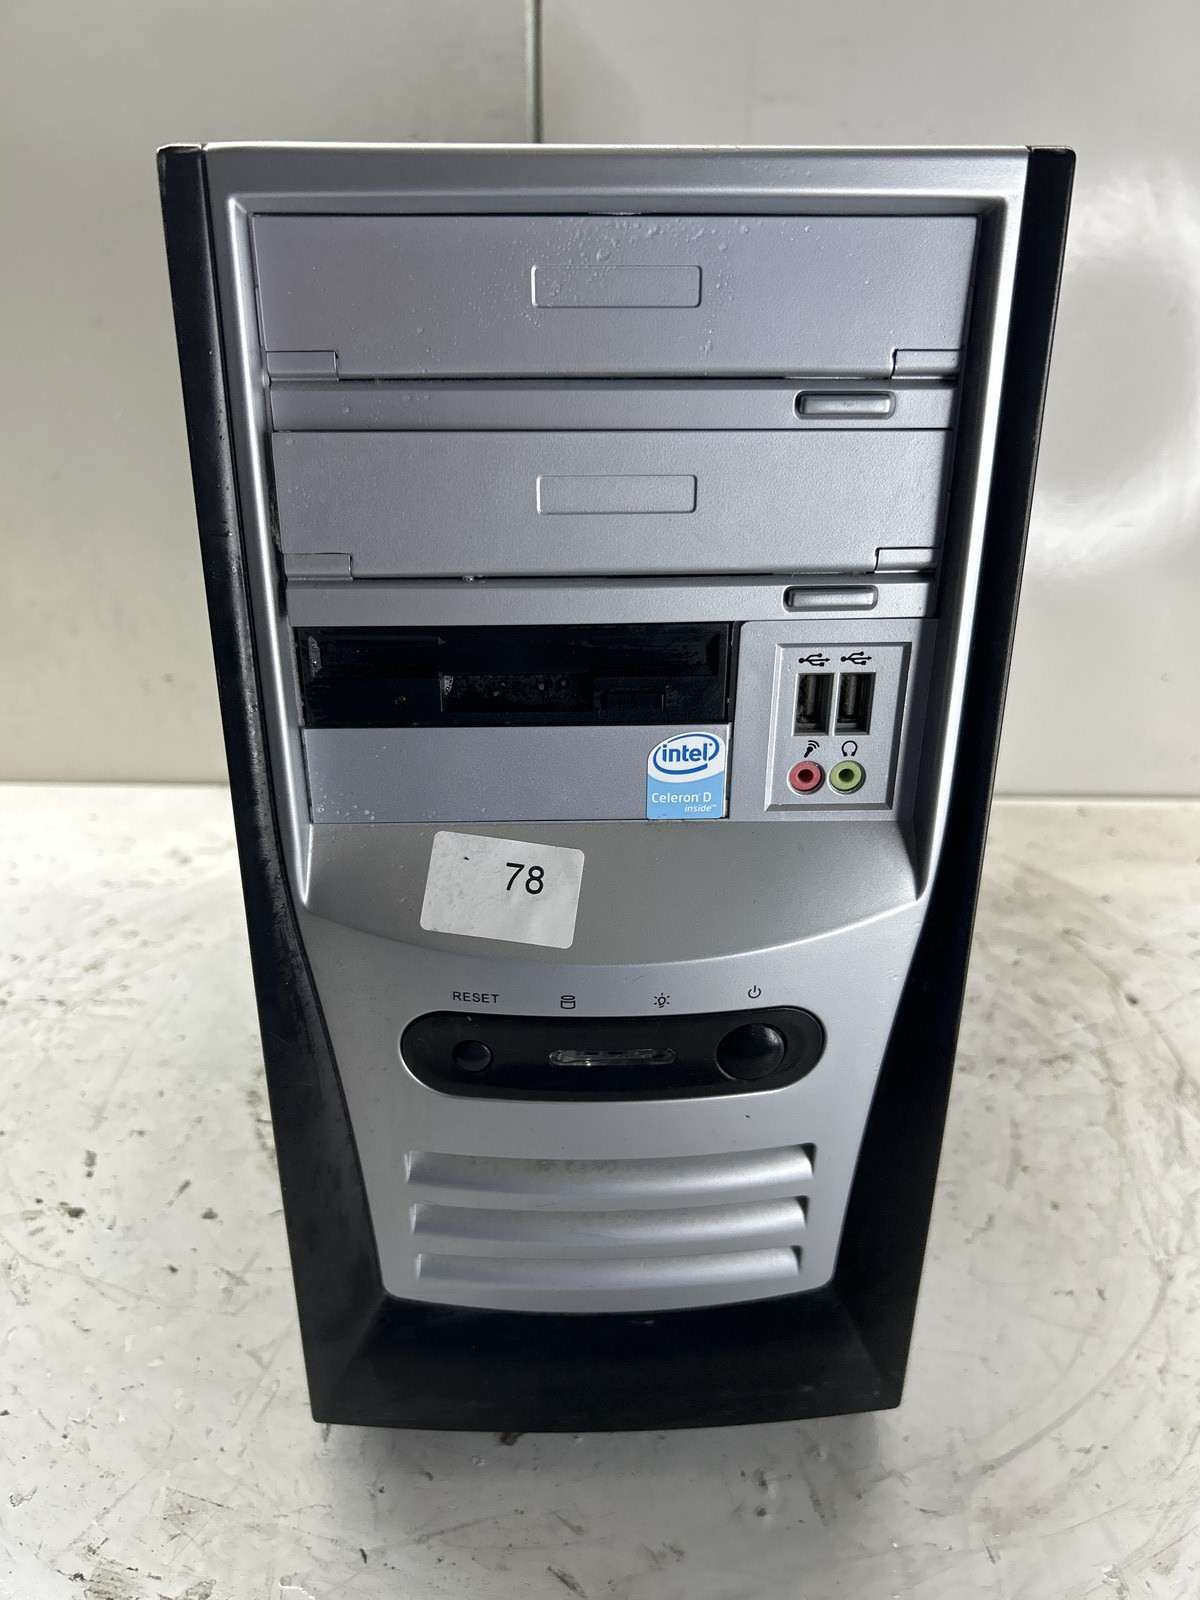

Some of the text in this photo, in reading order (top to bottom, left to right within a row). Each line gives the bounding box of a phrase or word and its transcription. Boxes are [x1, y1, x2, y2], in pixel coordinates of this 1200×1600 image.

[662, 743, 708, 762] intel
[651, 792, 712, 803] Celeron D
[506, 862, 545, 895] 78
[452, 991, 500, 1004] RESET
